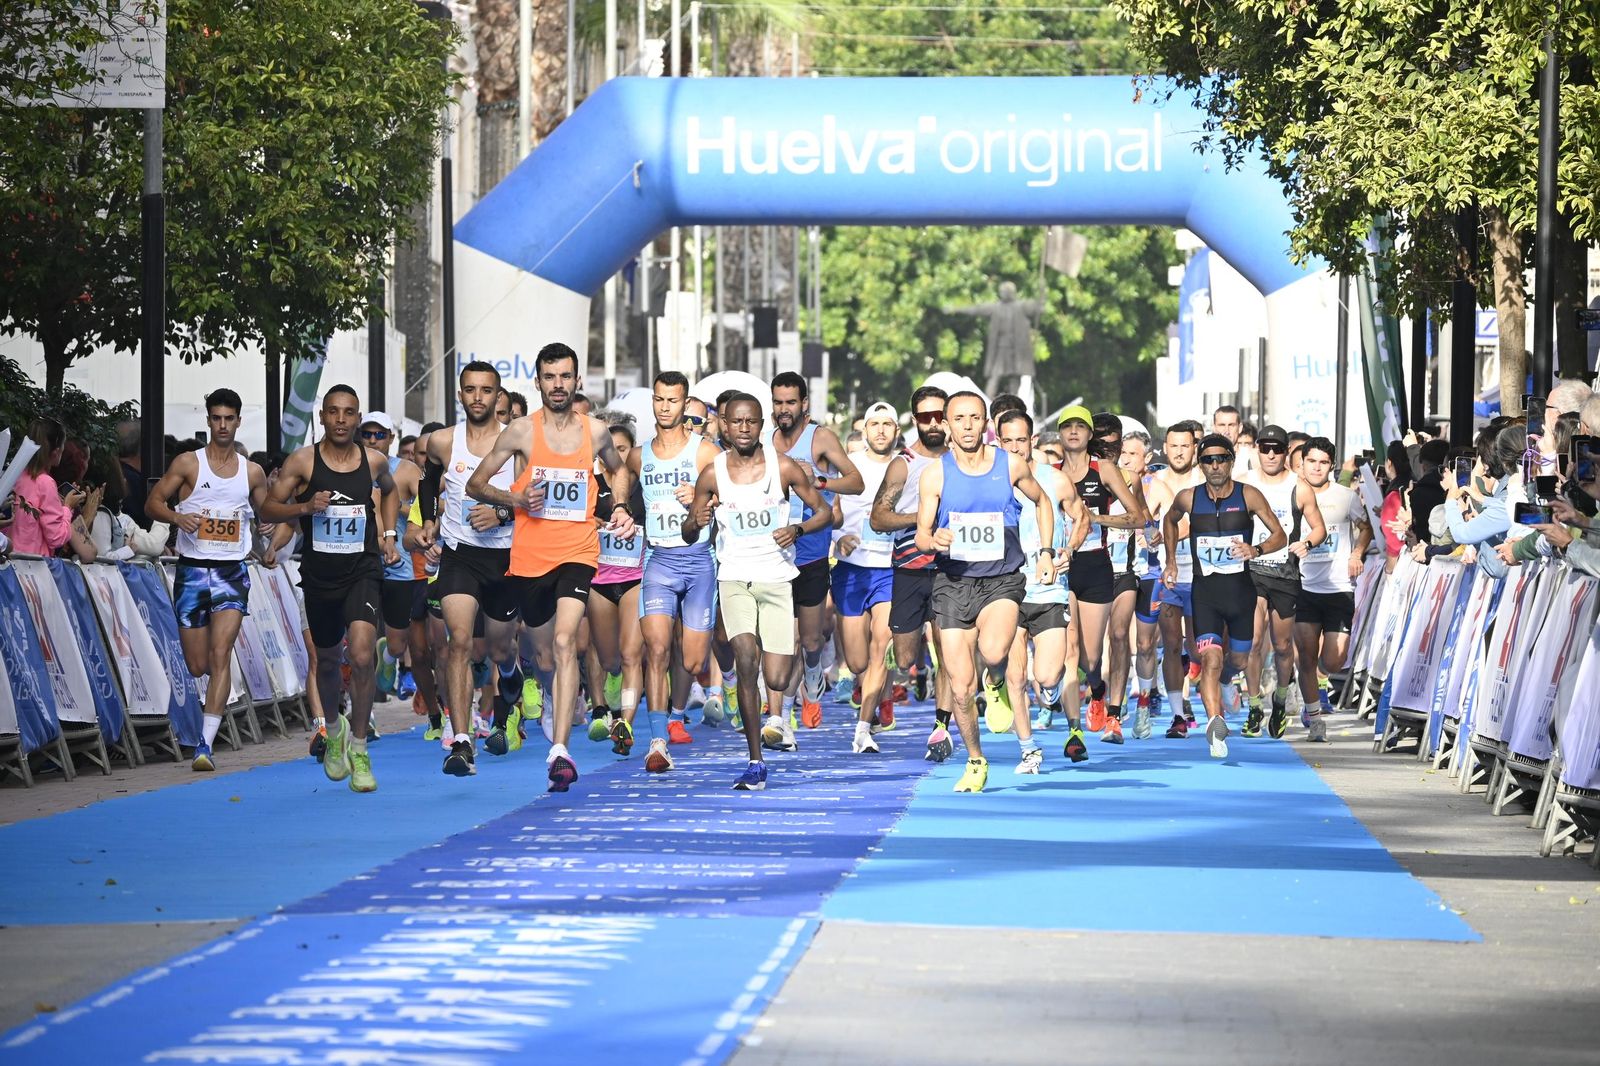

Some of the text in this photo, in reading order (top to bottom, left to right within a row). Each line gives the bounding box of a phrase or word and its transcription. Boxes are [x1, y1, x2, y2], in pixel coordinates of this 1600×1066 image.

[687, 112, 1162, 187] Huelva original
[535, 468, 585, 479] 2K 2K
[644, 467, 691, 487] nerja
[540, 481, 579, 502] 106
[352, 507, 363, 515] 2K
[735, 510, 771, 530] 180
[205, 518, 236, 535] 356
[322, 518, 357, 536] 114
[958, 526, 995, 544] 108
